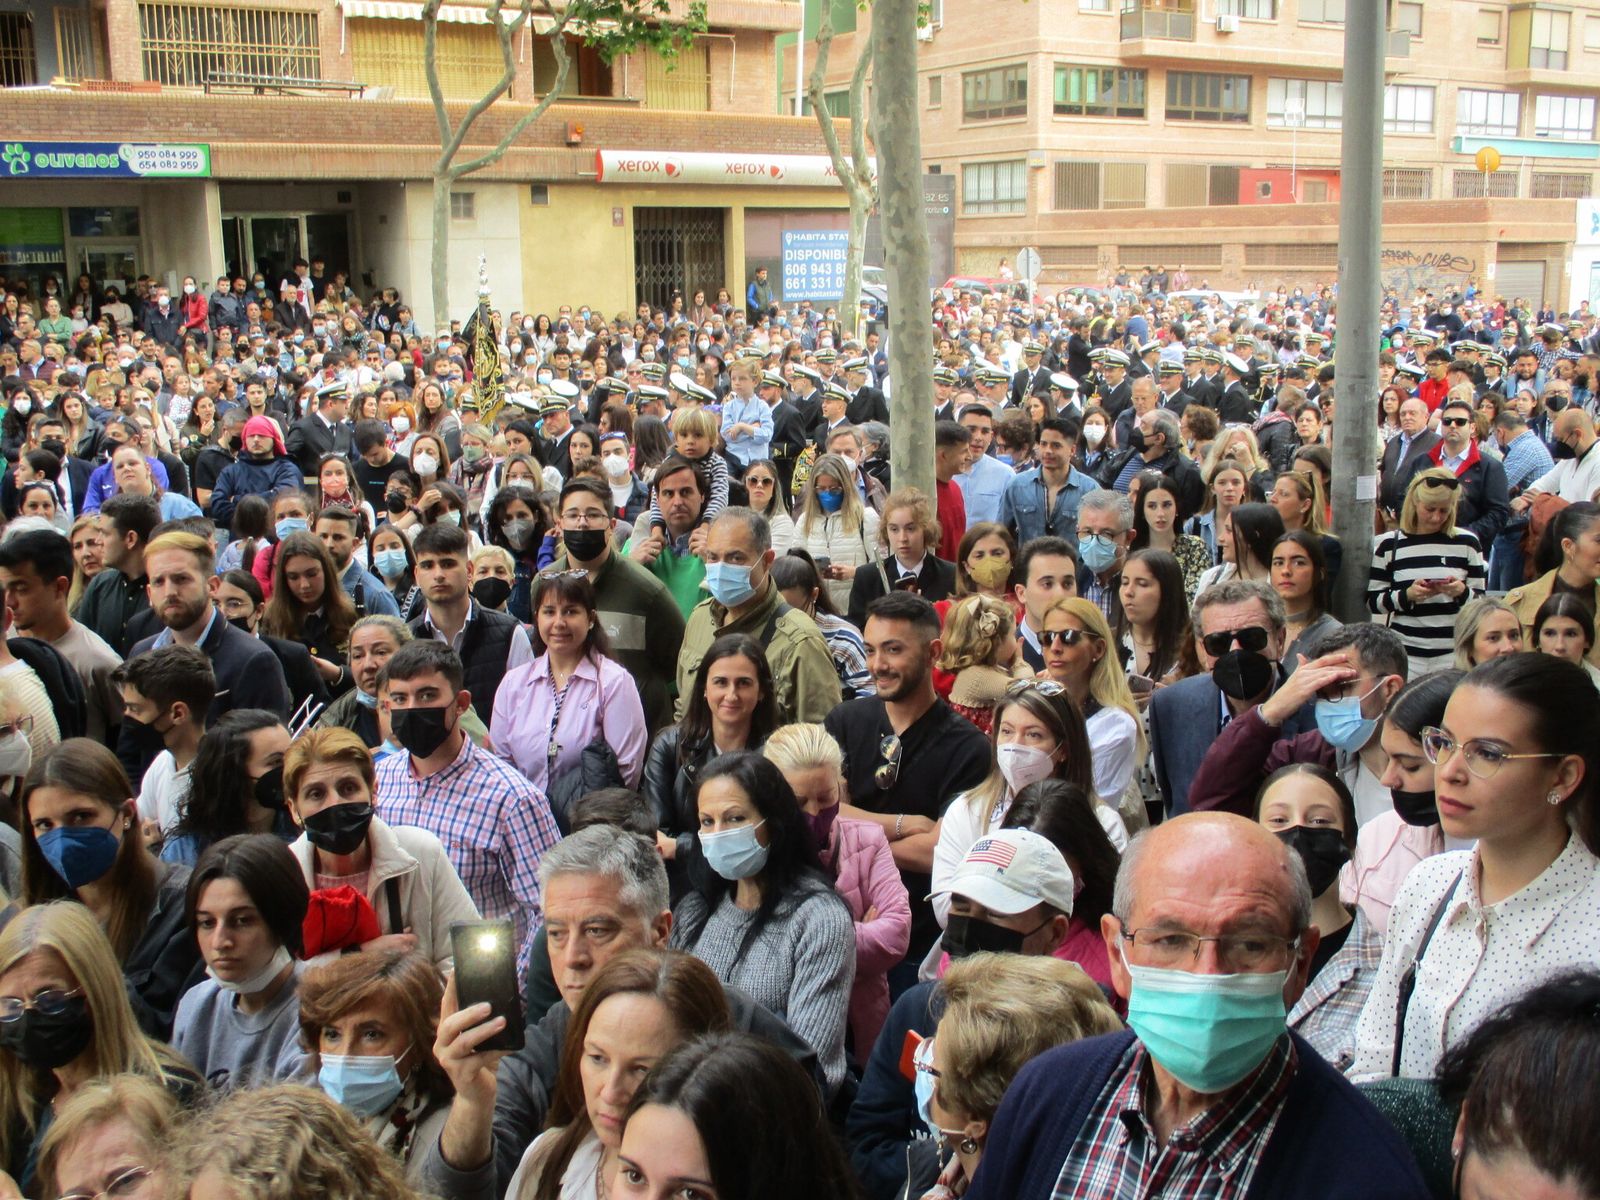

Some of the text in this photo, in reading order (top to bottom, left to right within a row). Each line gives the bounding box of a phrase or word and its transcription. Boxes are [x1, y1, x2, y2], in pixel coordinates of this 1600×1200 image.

[35, 153, 120, 168] OLIVEROS
[137, 150, 198, 159] 950 084 999
[138, 160, 199, 169] 654 082 959
[617, 159, 660, 173] xerox
[725, 161, 765, 175] xerox
[793, 233, 826, 241] HABITA
[785, 264, 807, 275] 606
[810, 263, 832, 275] 943
[785, 277, 806, 290] 661
[810, 277, 831, 289] 331
